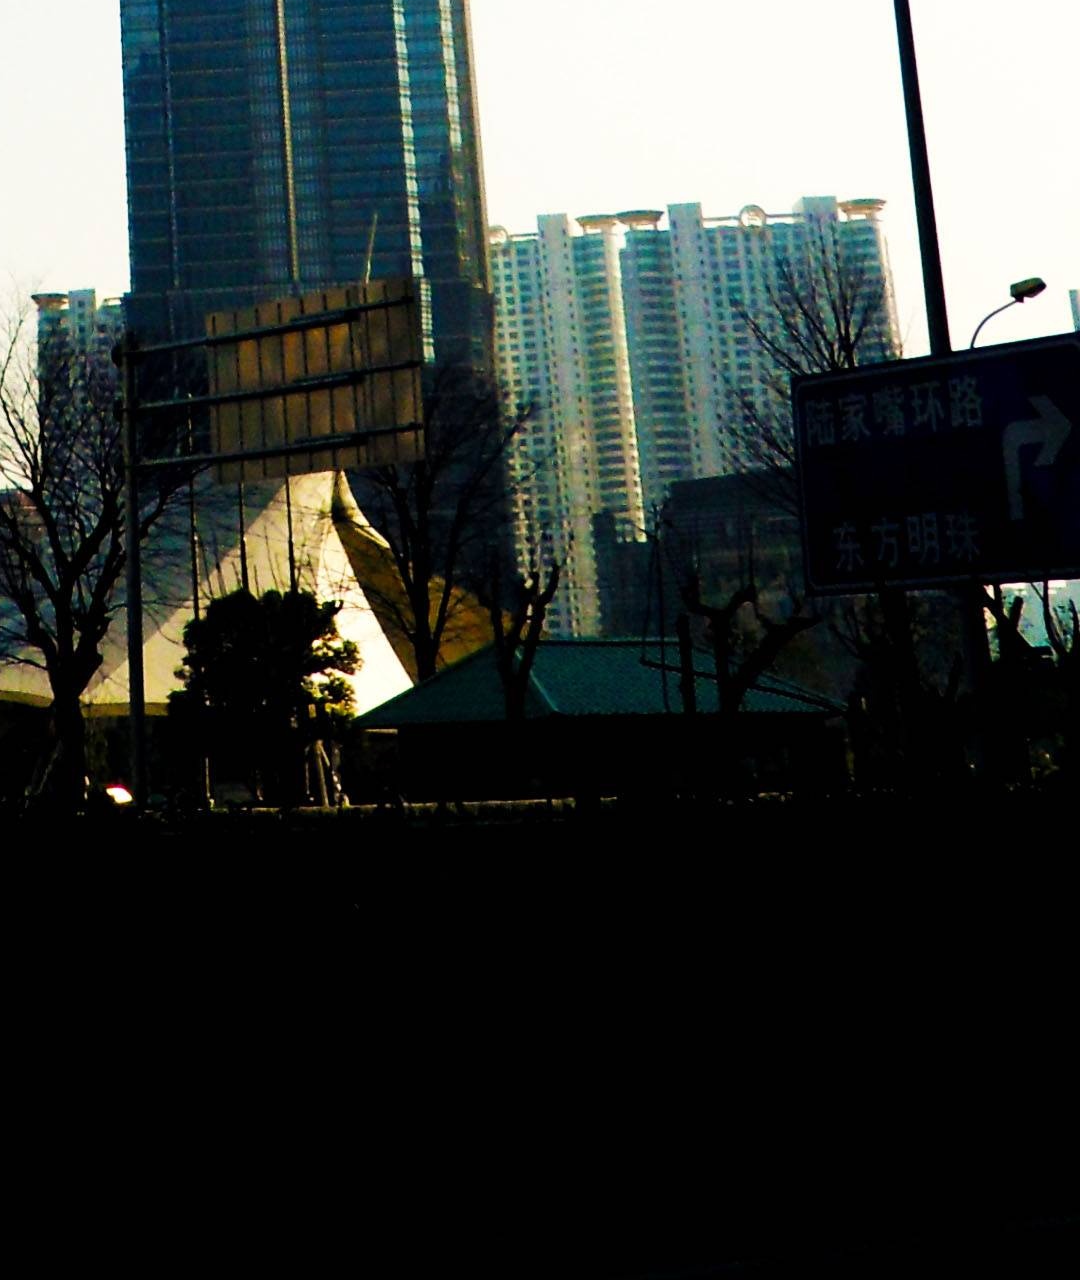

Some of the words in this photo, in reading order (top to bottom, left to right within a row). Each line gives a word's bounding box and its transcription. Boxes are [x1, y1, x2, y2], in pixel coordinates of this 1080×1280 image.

[804, 374, 985, 447] 陆家嘴环路
[831, 512, 981, 573] 东方明珠
